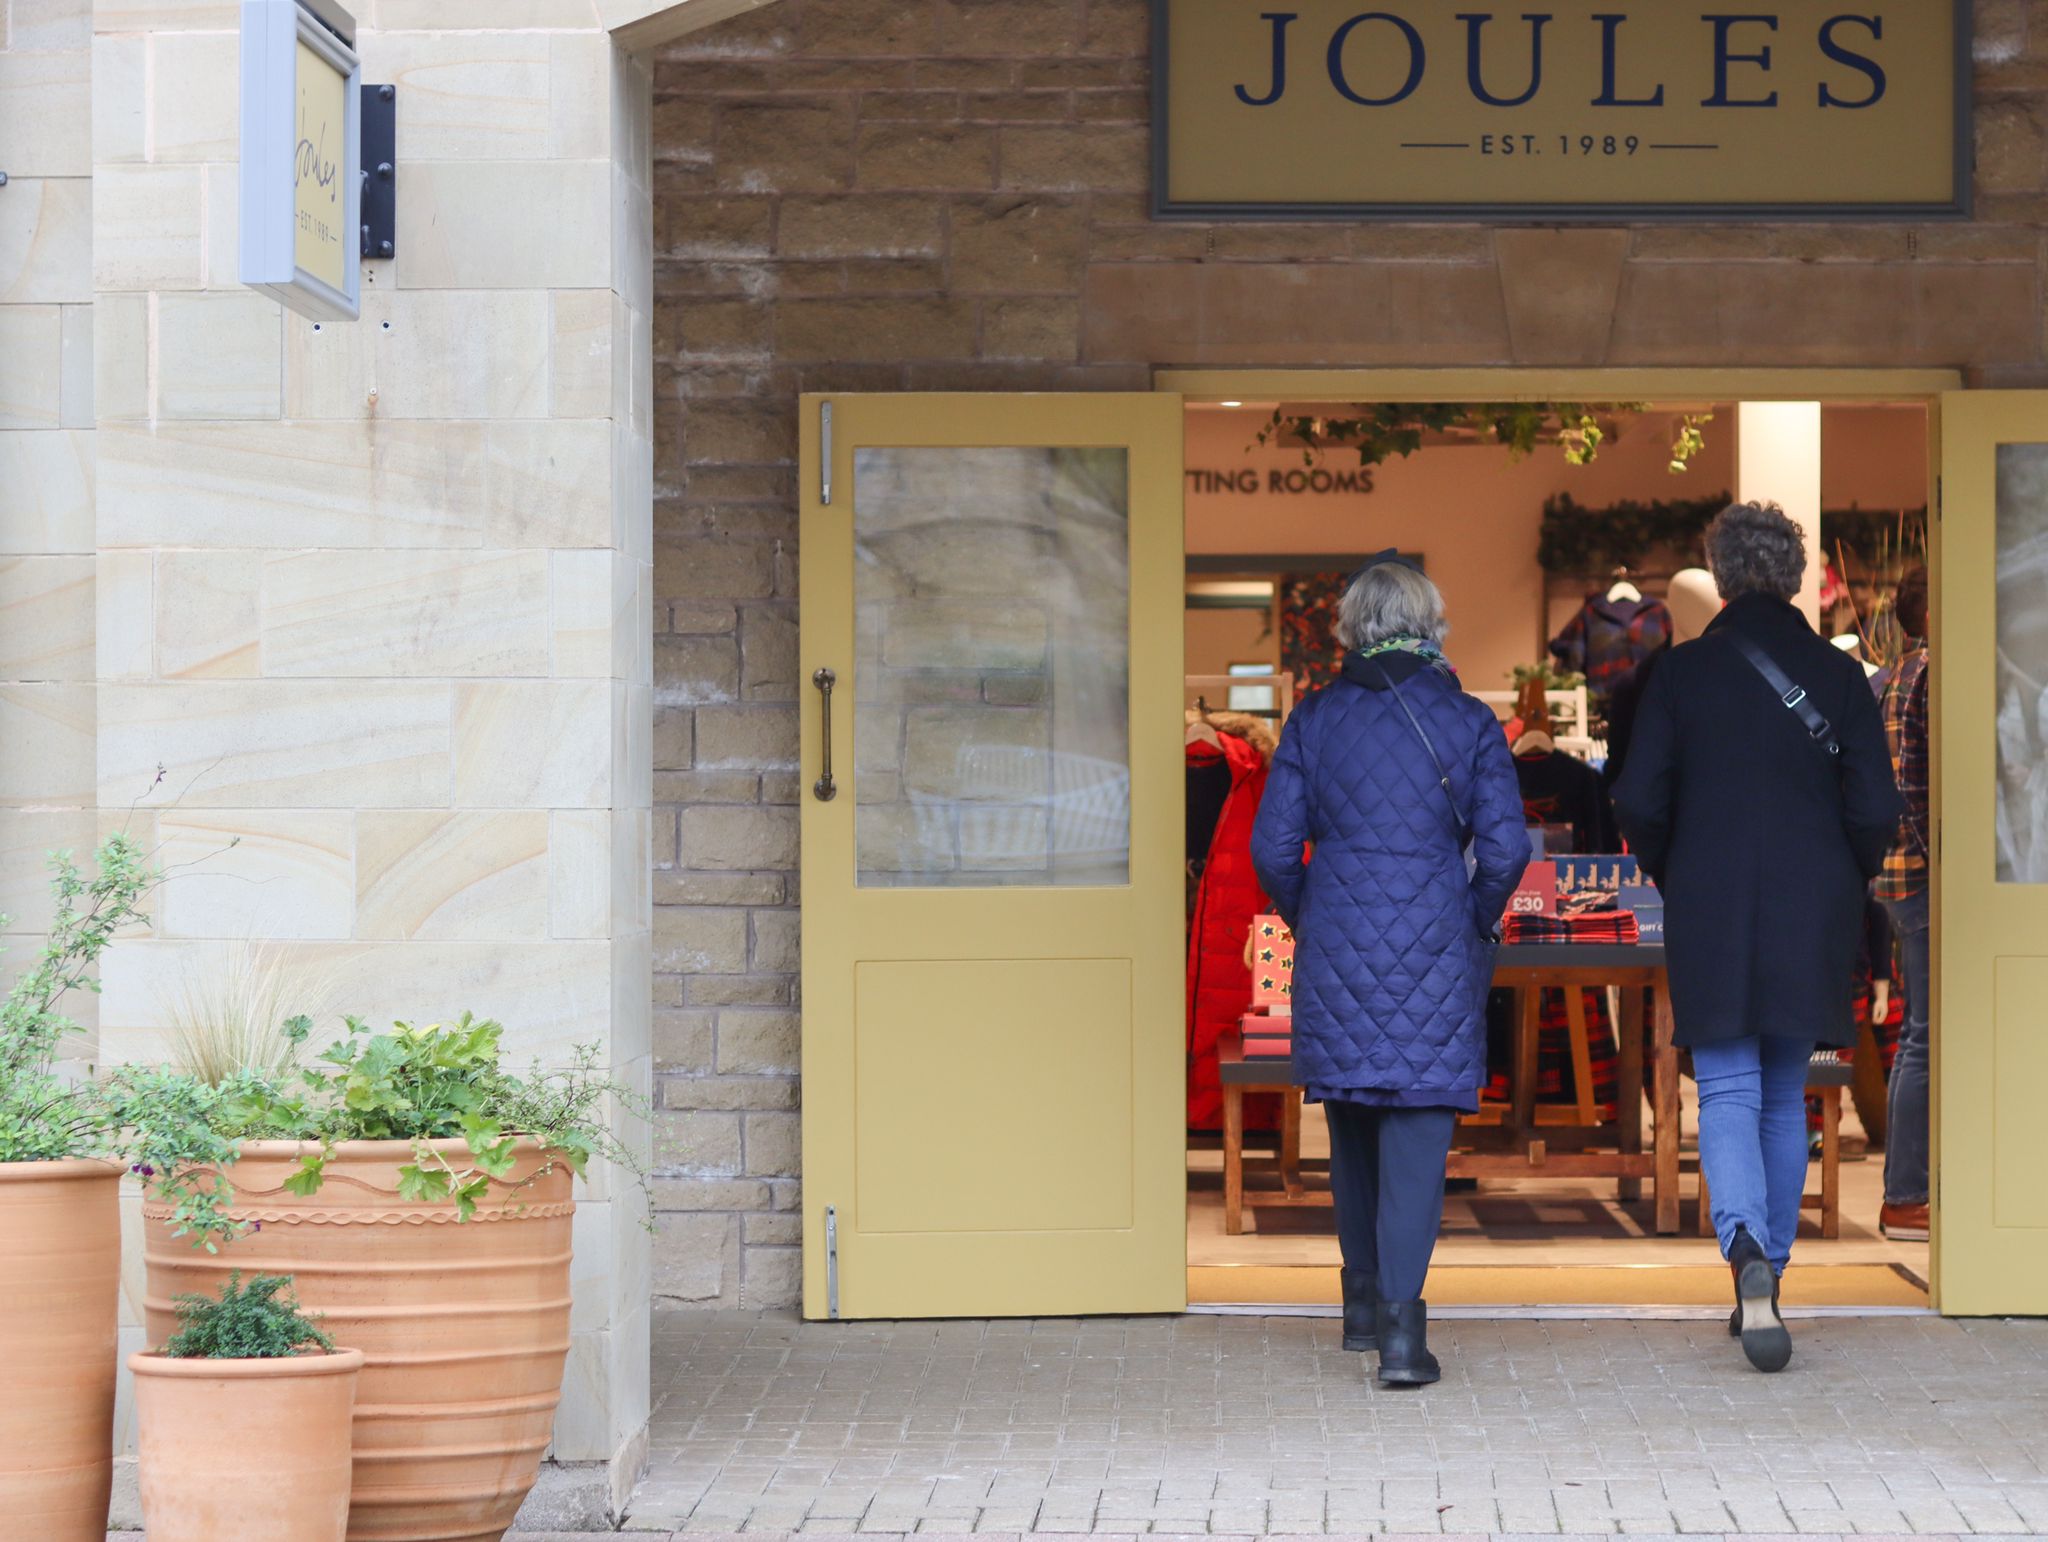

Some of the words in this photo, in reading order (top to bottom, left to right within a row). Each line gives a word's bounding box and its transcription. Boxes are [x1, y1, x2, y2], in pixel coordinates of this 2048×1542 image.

[1232, 11, 1888, 109] JOULES
[1480, 134, 1541, 156] EST.
[1559, 135, 1639, 156] 1989
[1185, 469, 1260, 494] TING
[1268, 469, 1375, 494] ROOMS
[1512, 896, 1544, 912] £30
